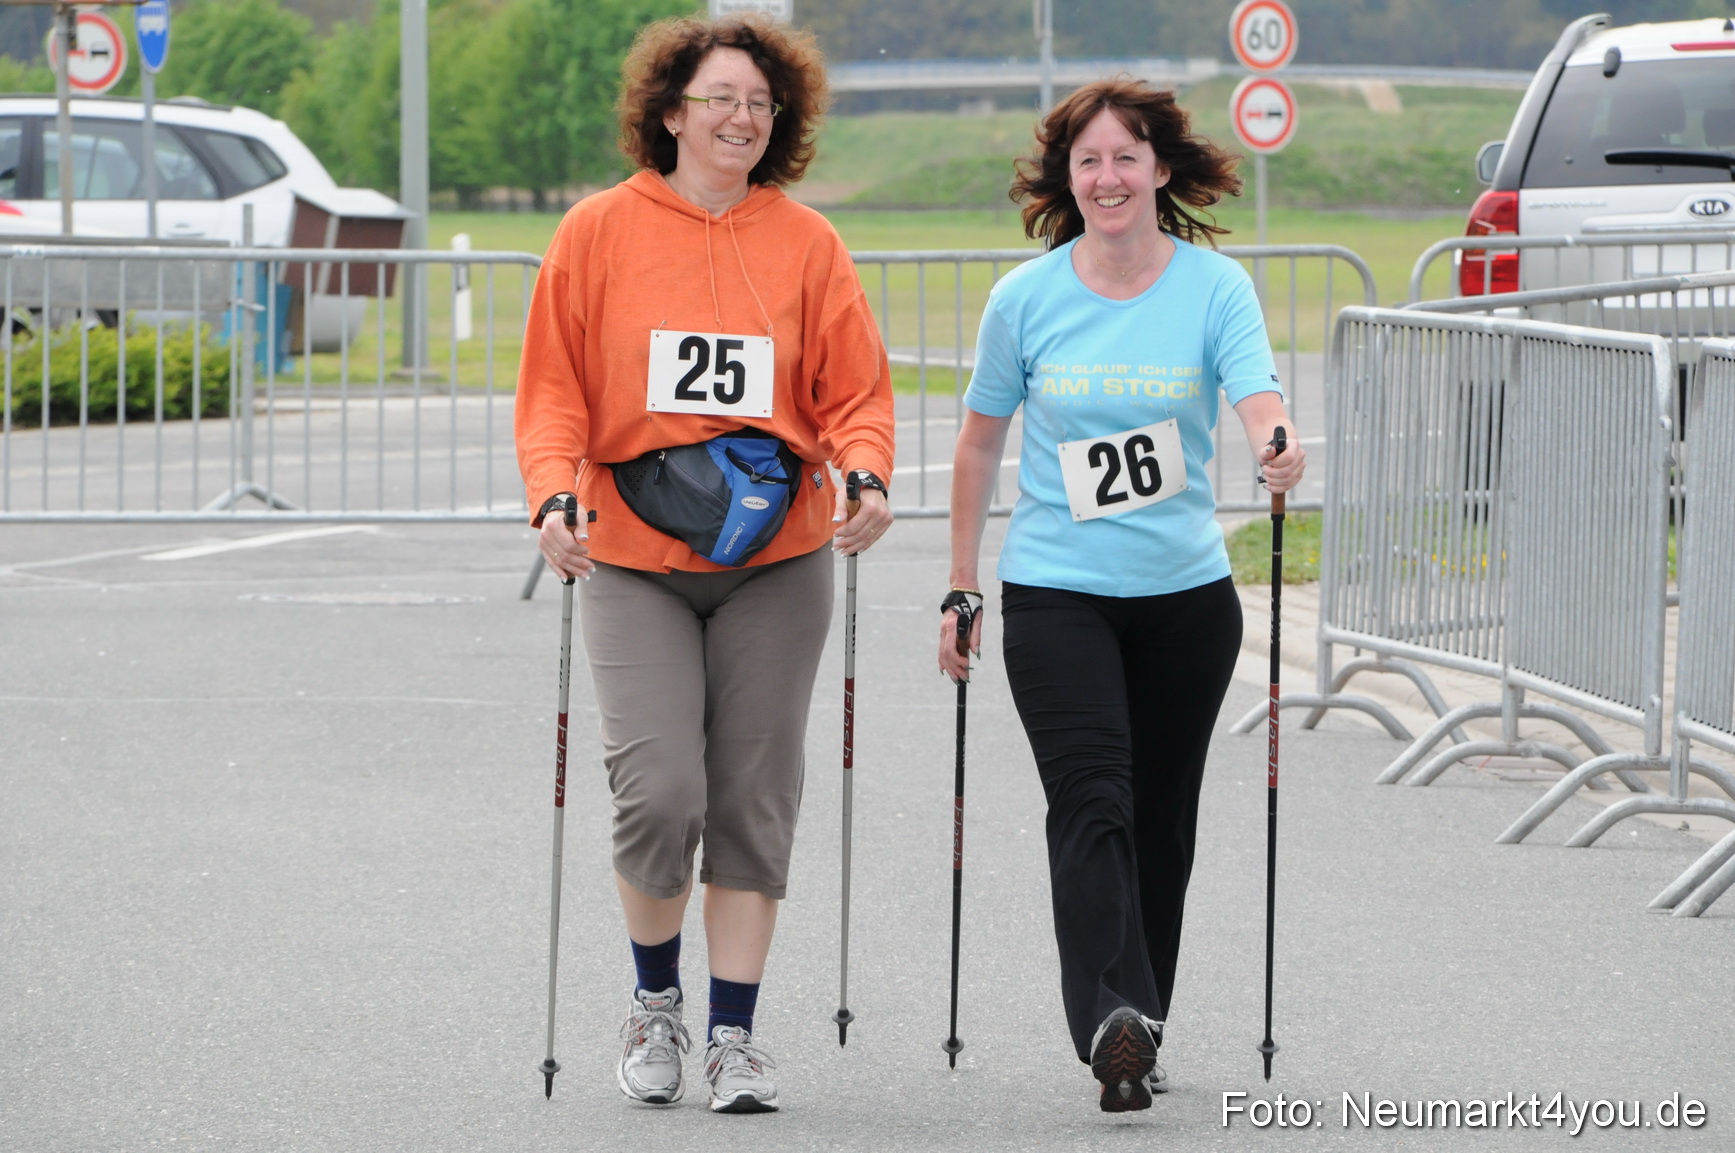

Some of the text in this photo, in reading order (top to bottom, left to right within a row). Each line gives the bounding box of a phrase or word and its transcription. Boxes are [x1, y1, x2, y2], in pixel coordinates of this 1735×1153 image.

[1247, 19, 1281, 51] 60
[1694, 201, 1725, 215] KIA
[674, 335, 746, 405] 25
[1041, 378, 1089, 395] AM
[1138, 365, 1167, 376] ICH
[1087, 434, 1162, 507] 26
[723, 526, 743, 555] NORDIC
[1267, 693, 1279, 777] Flash
[555, 723, 568, 797] Flash
[953, 805, 963, 861] Flash
